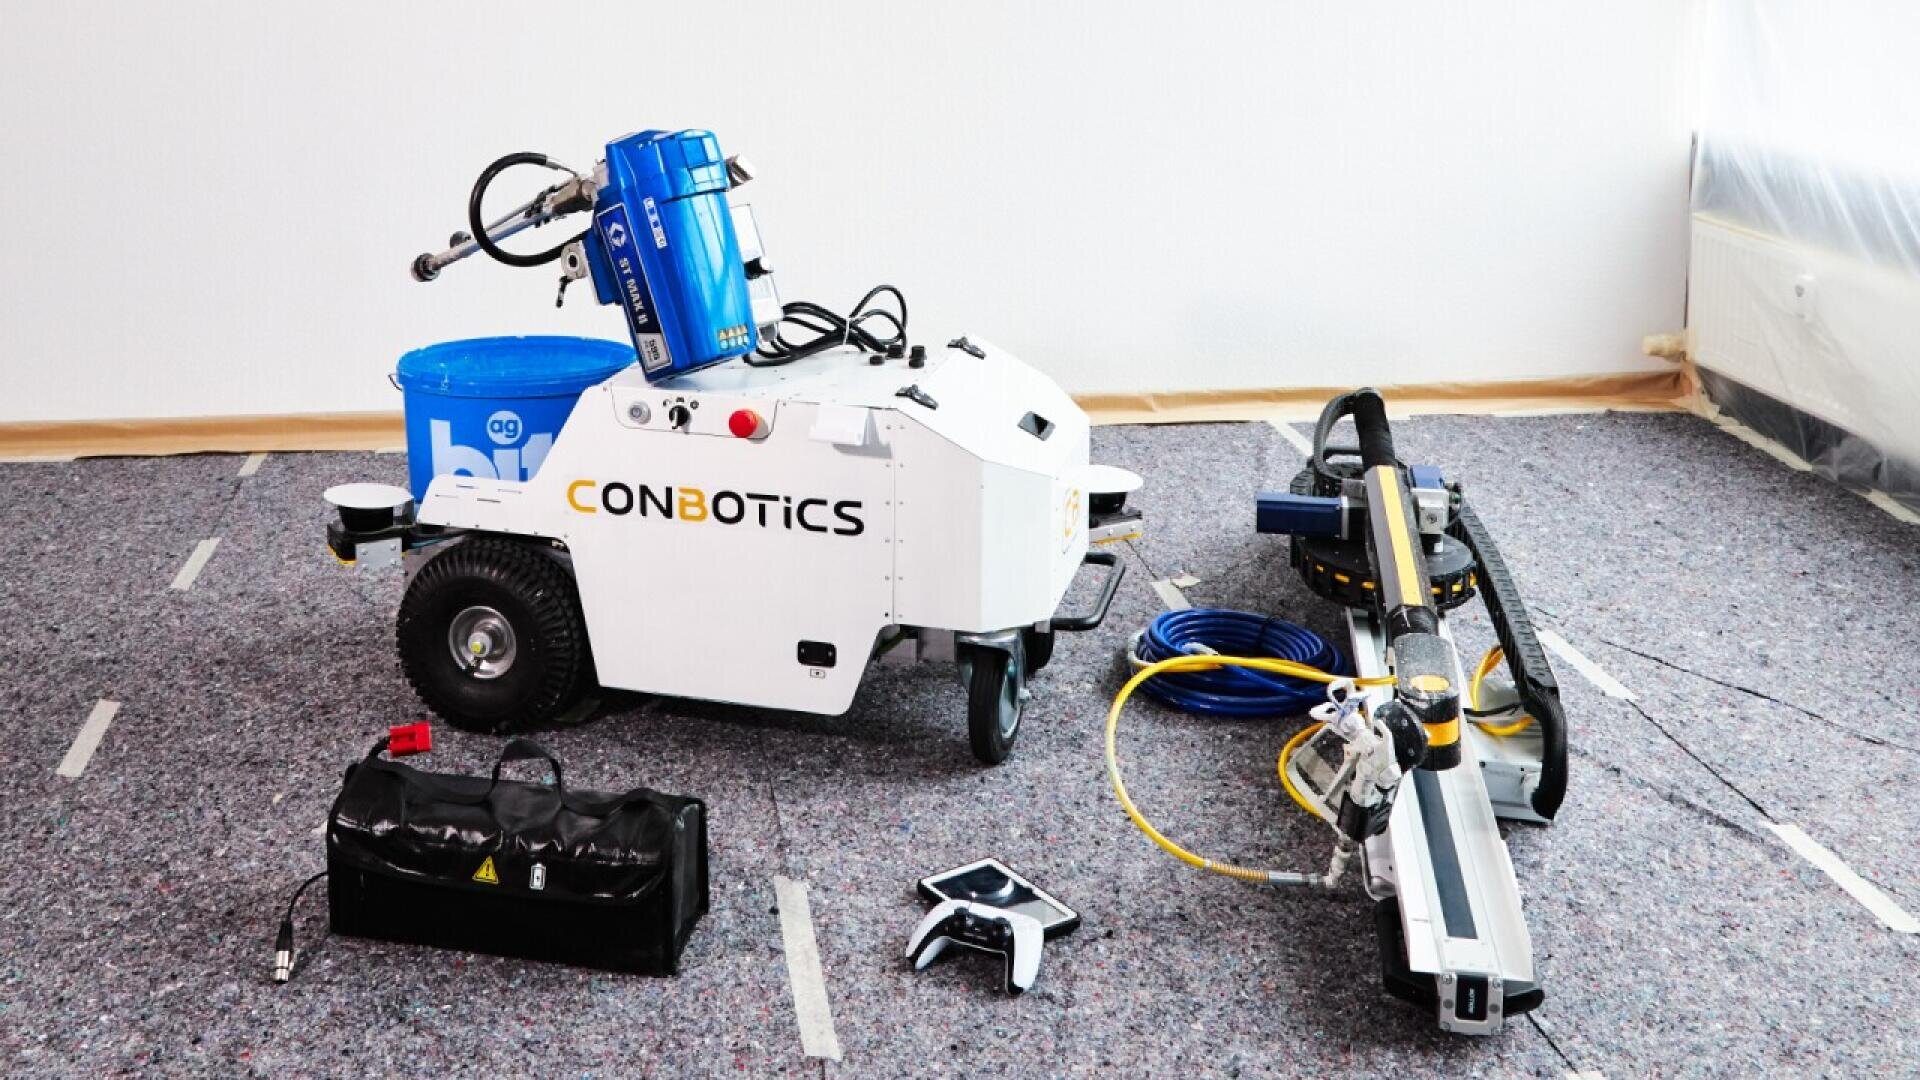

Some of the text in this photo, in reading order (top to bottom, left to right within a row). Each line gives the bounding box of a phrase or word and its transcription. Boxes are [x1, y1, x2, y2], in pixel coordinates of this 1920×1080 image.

[619, 257, 632, 274] ST
[627, 278, 644, 312] MAX
[489, 419, 518, 438] ag
